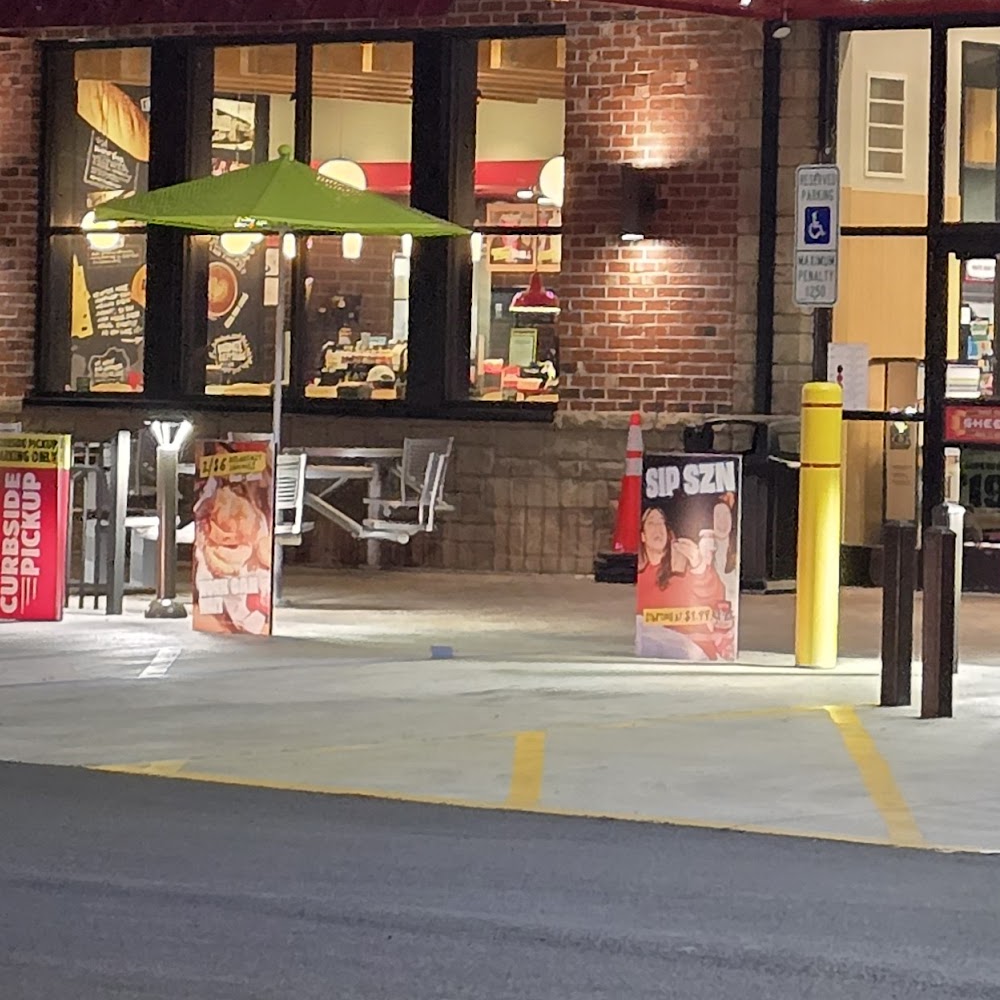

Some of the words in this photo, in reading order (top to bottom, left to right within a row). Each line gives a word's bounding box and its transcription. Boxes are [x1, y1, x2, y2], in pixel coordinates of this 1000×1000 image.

[798, 270, 833, 282] PENALTY
[646, 465, 680, 498] SIP
[683, 461, 735, 495] SZN
[0, 472, 21, 614] CURBSIDE
[20, 472, 42, 576] PICKUP
